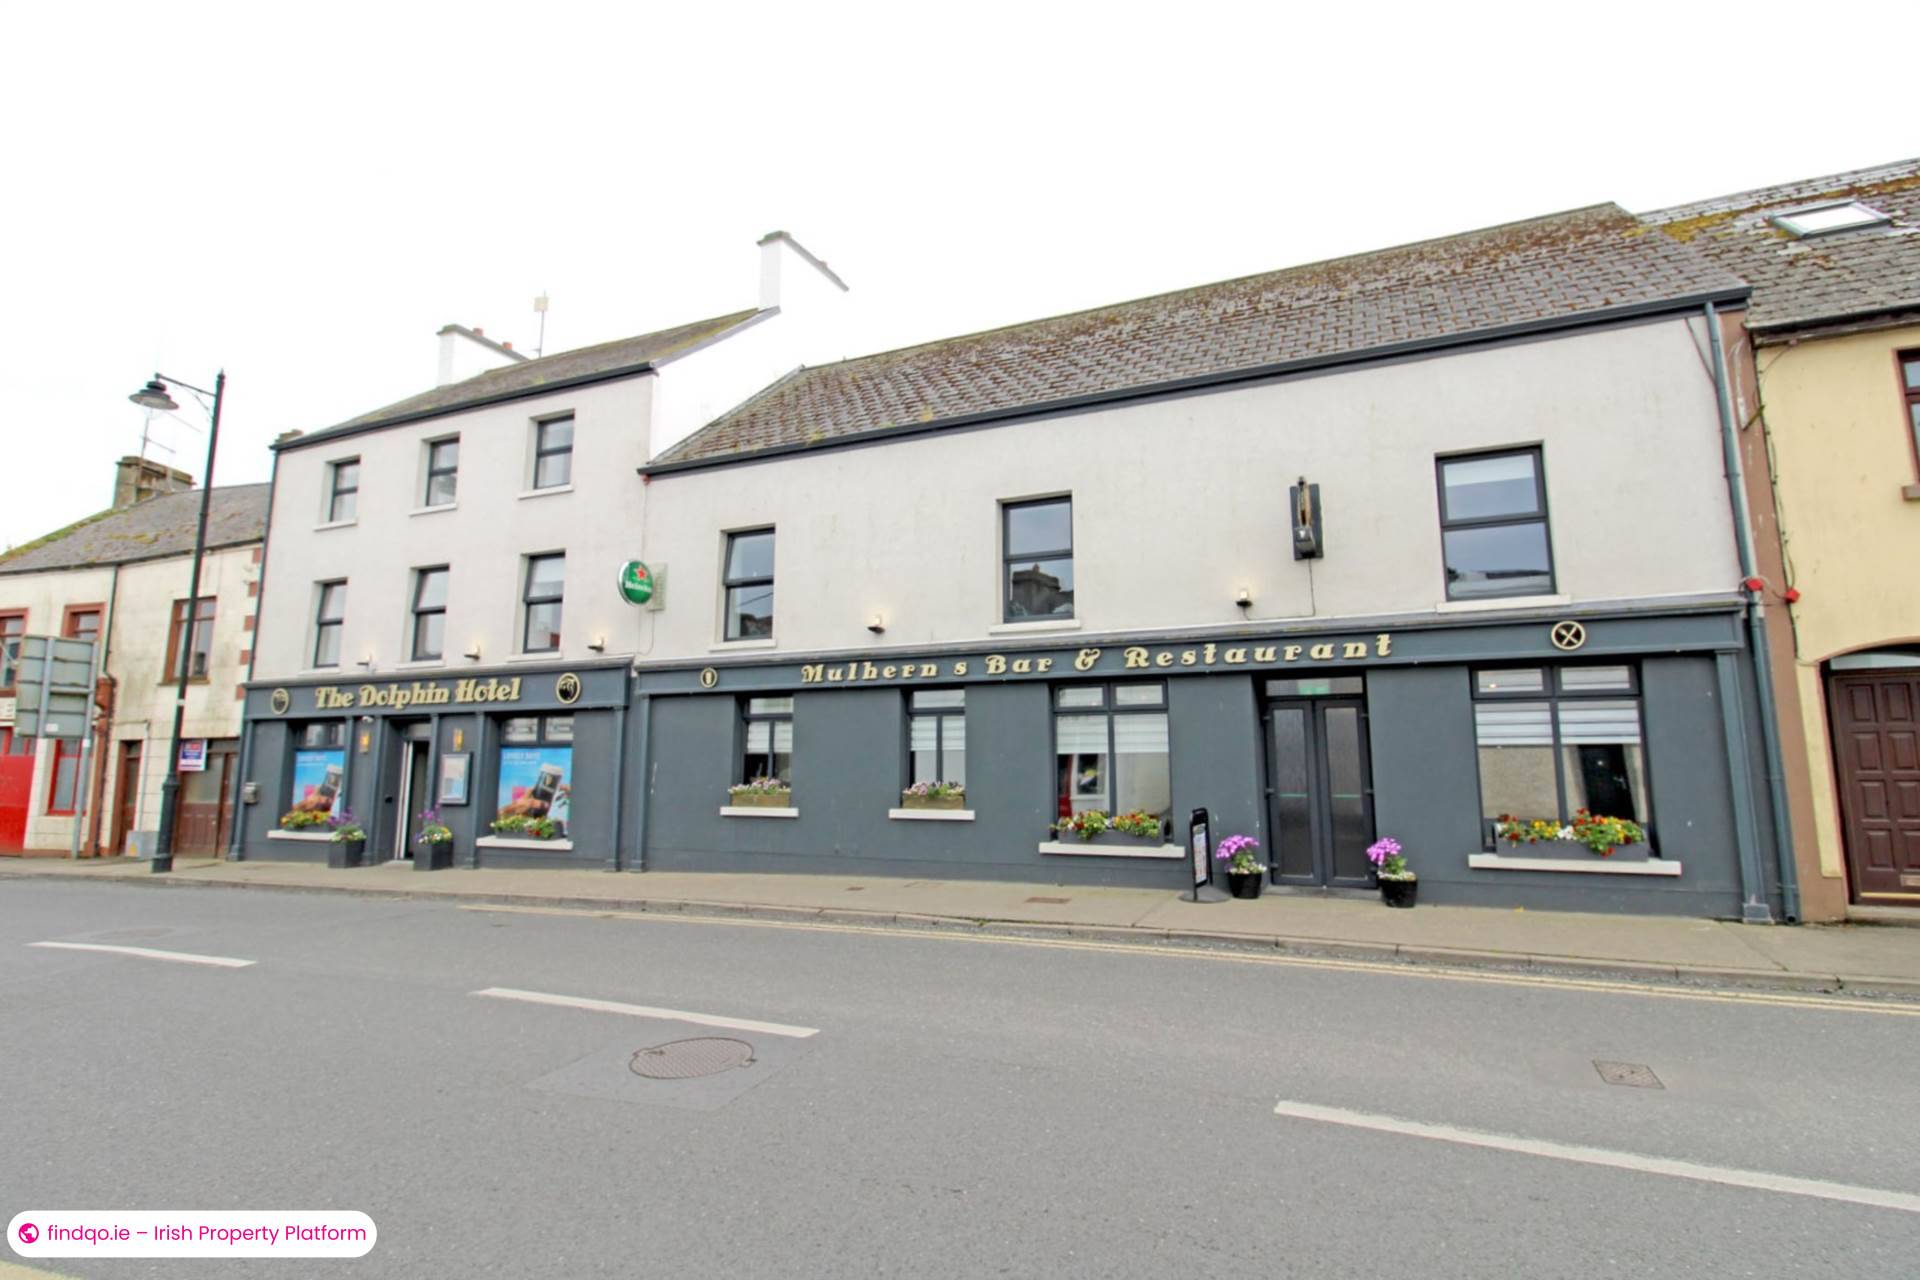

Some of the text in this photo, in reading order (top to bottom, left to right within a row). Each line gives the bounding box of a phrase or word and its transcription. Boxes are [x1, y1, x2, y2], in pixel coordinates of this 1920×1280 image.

[802, 661, 938, 683] Mulhern
[985, 655, 1053, 675] Bar
[1074, 648, 1101, 671] &
[1123, 633, 1393, 668] Restaurant
[316, 677, 521, 709] The Dolphin Hotel
